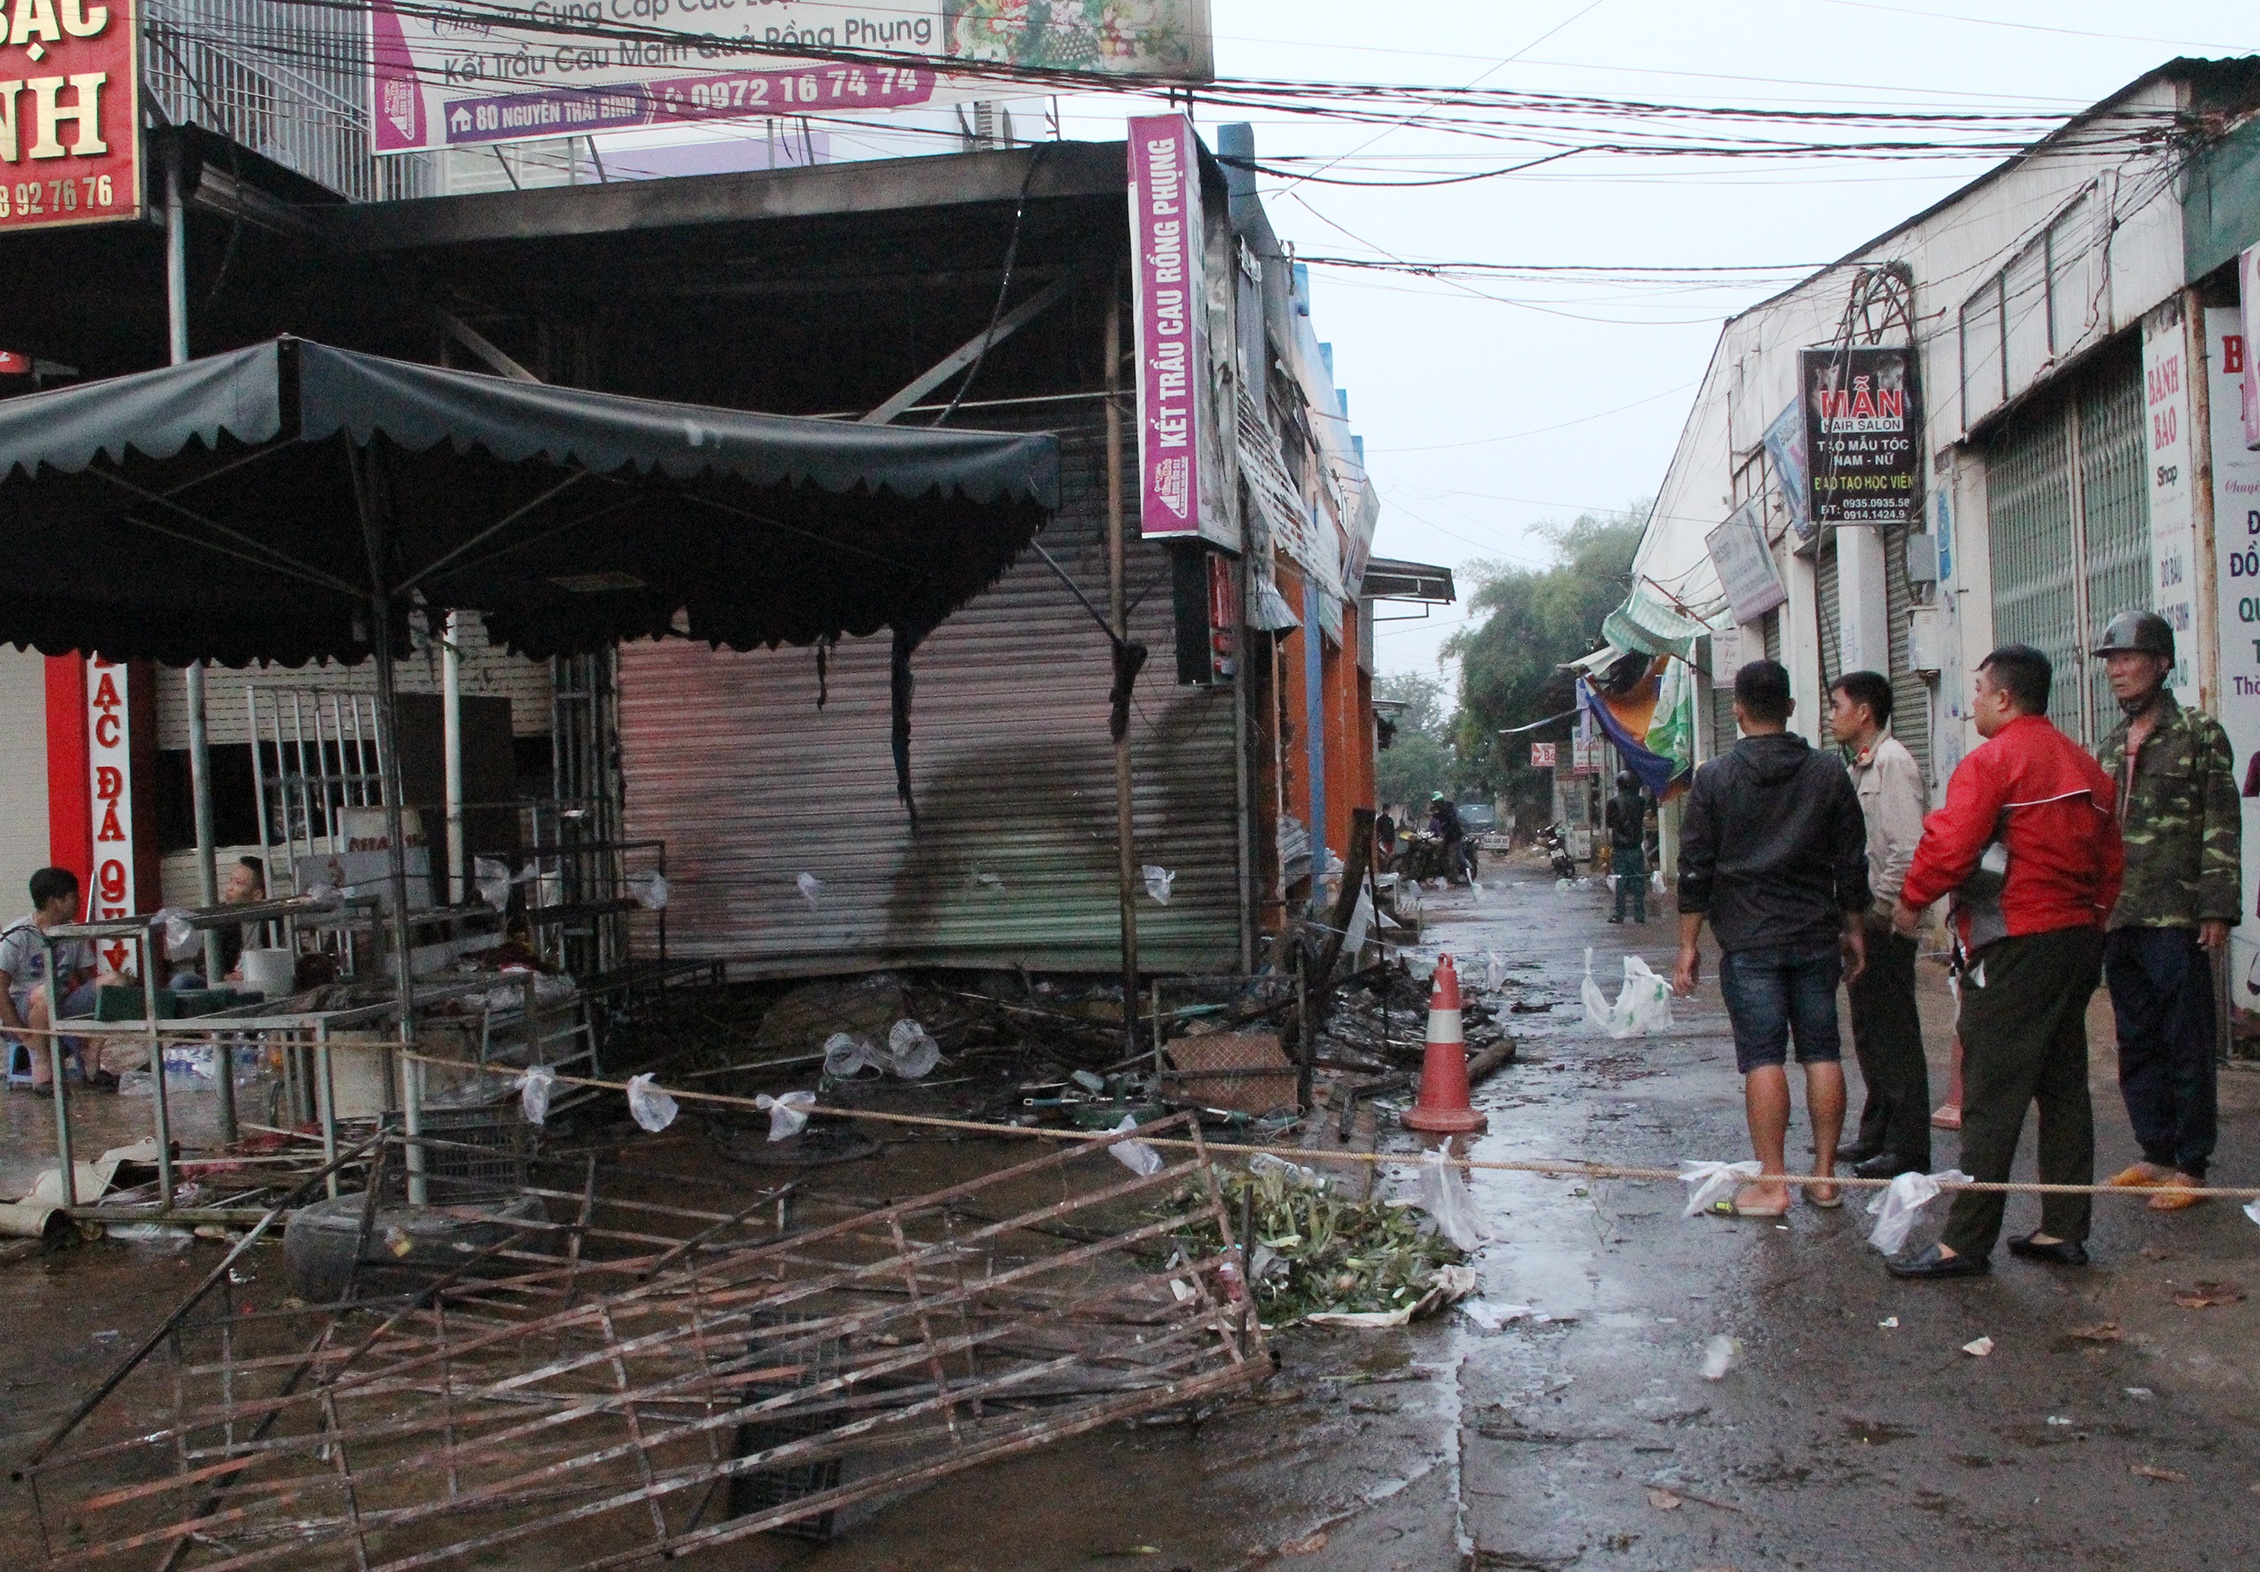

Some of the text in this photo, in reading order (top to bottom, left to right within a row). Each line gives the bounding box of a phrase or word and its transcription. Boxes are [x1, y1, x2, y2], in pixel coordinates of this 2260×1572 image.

[554, 46, 610, 73] Cau
[845, 18, 932, 48] Phụng
[691, 67, 918, 111] 0972 16 74 74
[476, 104, 499, 131] 80
[15, 182, 44, 216] 92
[48, 178, 78, 212] 76
[82, 174, 113, 207] 76
[1147, 137, 1184, 215] PHỤNG
[1146, 220, 1182, 284] RỒNG
[1156, 289, 1185, 336] CAU
[1149, 341, 1186, 401] TRẦU
[2147, 354, 2180, 407] BÁNH
[1820, 375, 1903, 419] MẪN
[1150, 406, 1188, 448] KẾT
[1848, 435, 1878, 451] MẪU
[1881, 436, 1910, 451] TÓC
[1857, 420, 1900, 431] SALON
[2153, 405, 2178, 451] BAO
[1833, 454, 1863, 467] NAM
[2156, 465, 2178, 488] Shop
[1840, 475, 1863, 493] TẠO
[1864, 474, 1888, 492] HỌC
[96, 765, 126, 842] ĐÁ
